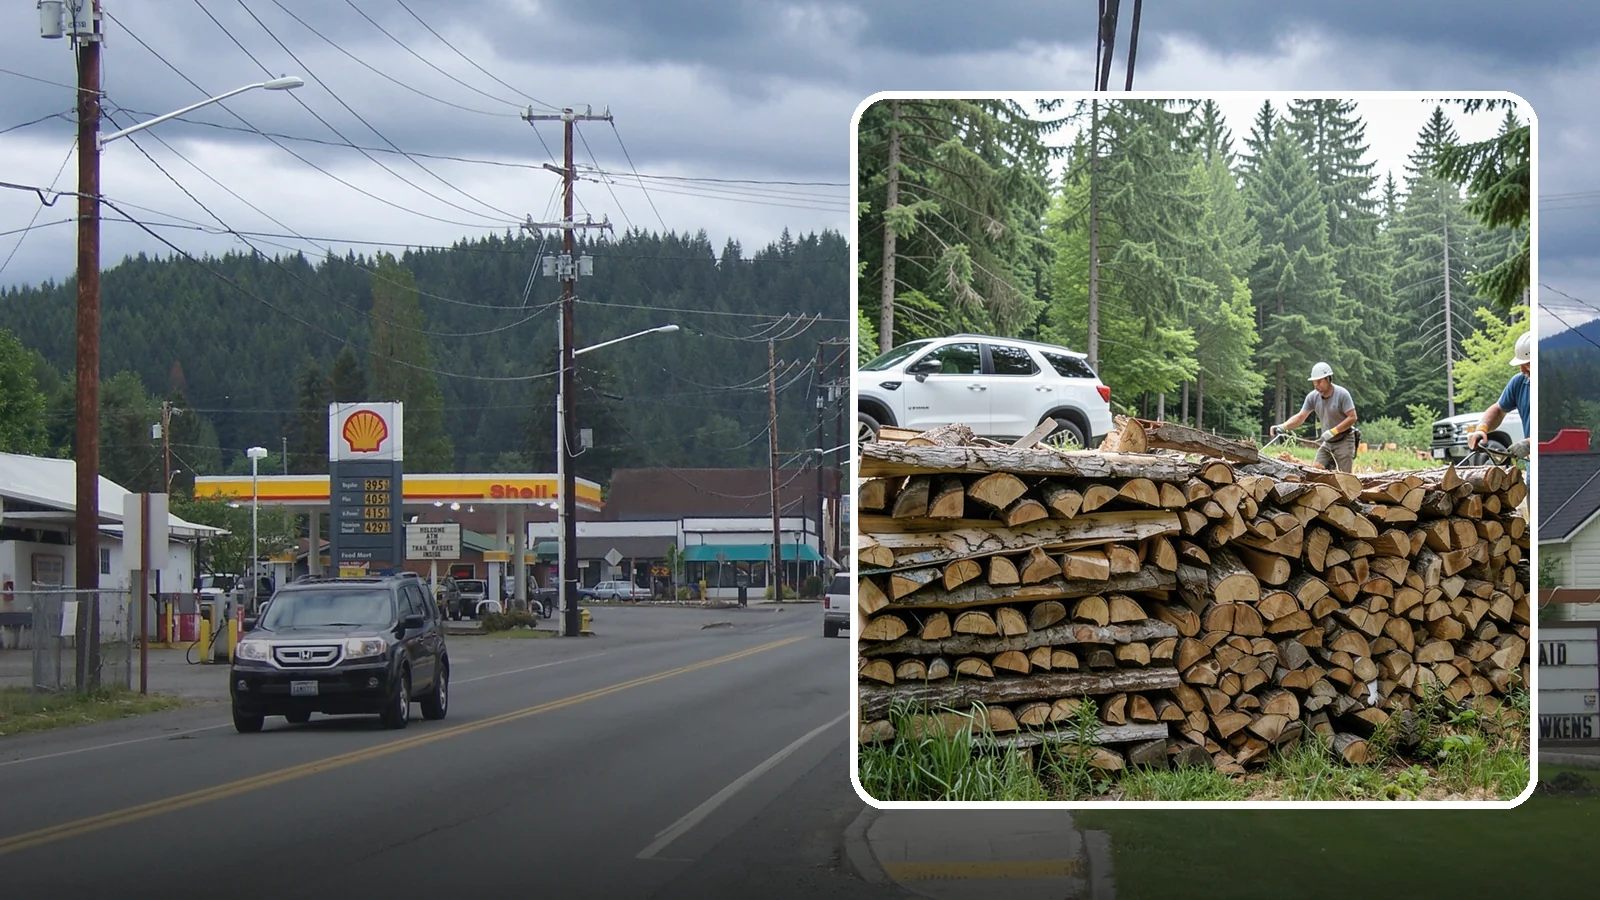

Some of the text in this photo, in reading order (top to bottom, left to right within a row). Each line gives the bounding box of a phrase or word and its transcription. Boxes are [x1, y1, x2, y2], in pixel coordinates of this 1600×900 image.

[366, 480, 384, 490] 395
[489, 484, 547, 499] Shell
[366, 494, 384, 504] 405
[366, 508, 384, 518] 415
[366, 522, 384, 532] 429
[1538, 643, 1566, 666] AID
[1538, 716, 1592, 739] WKENS
